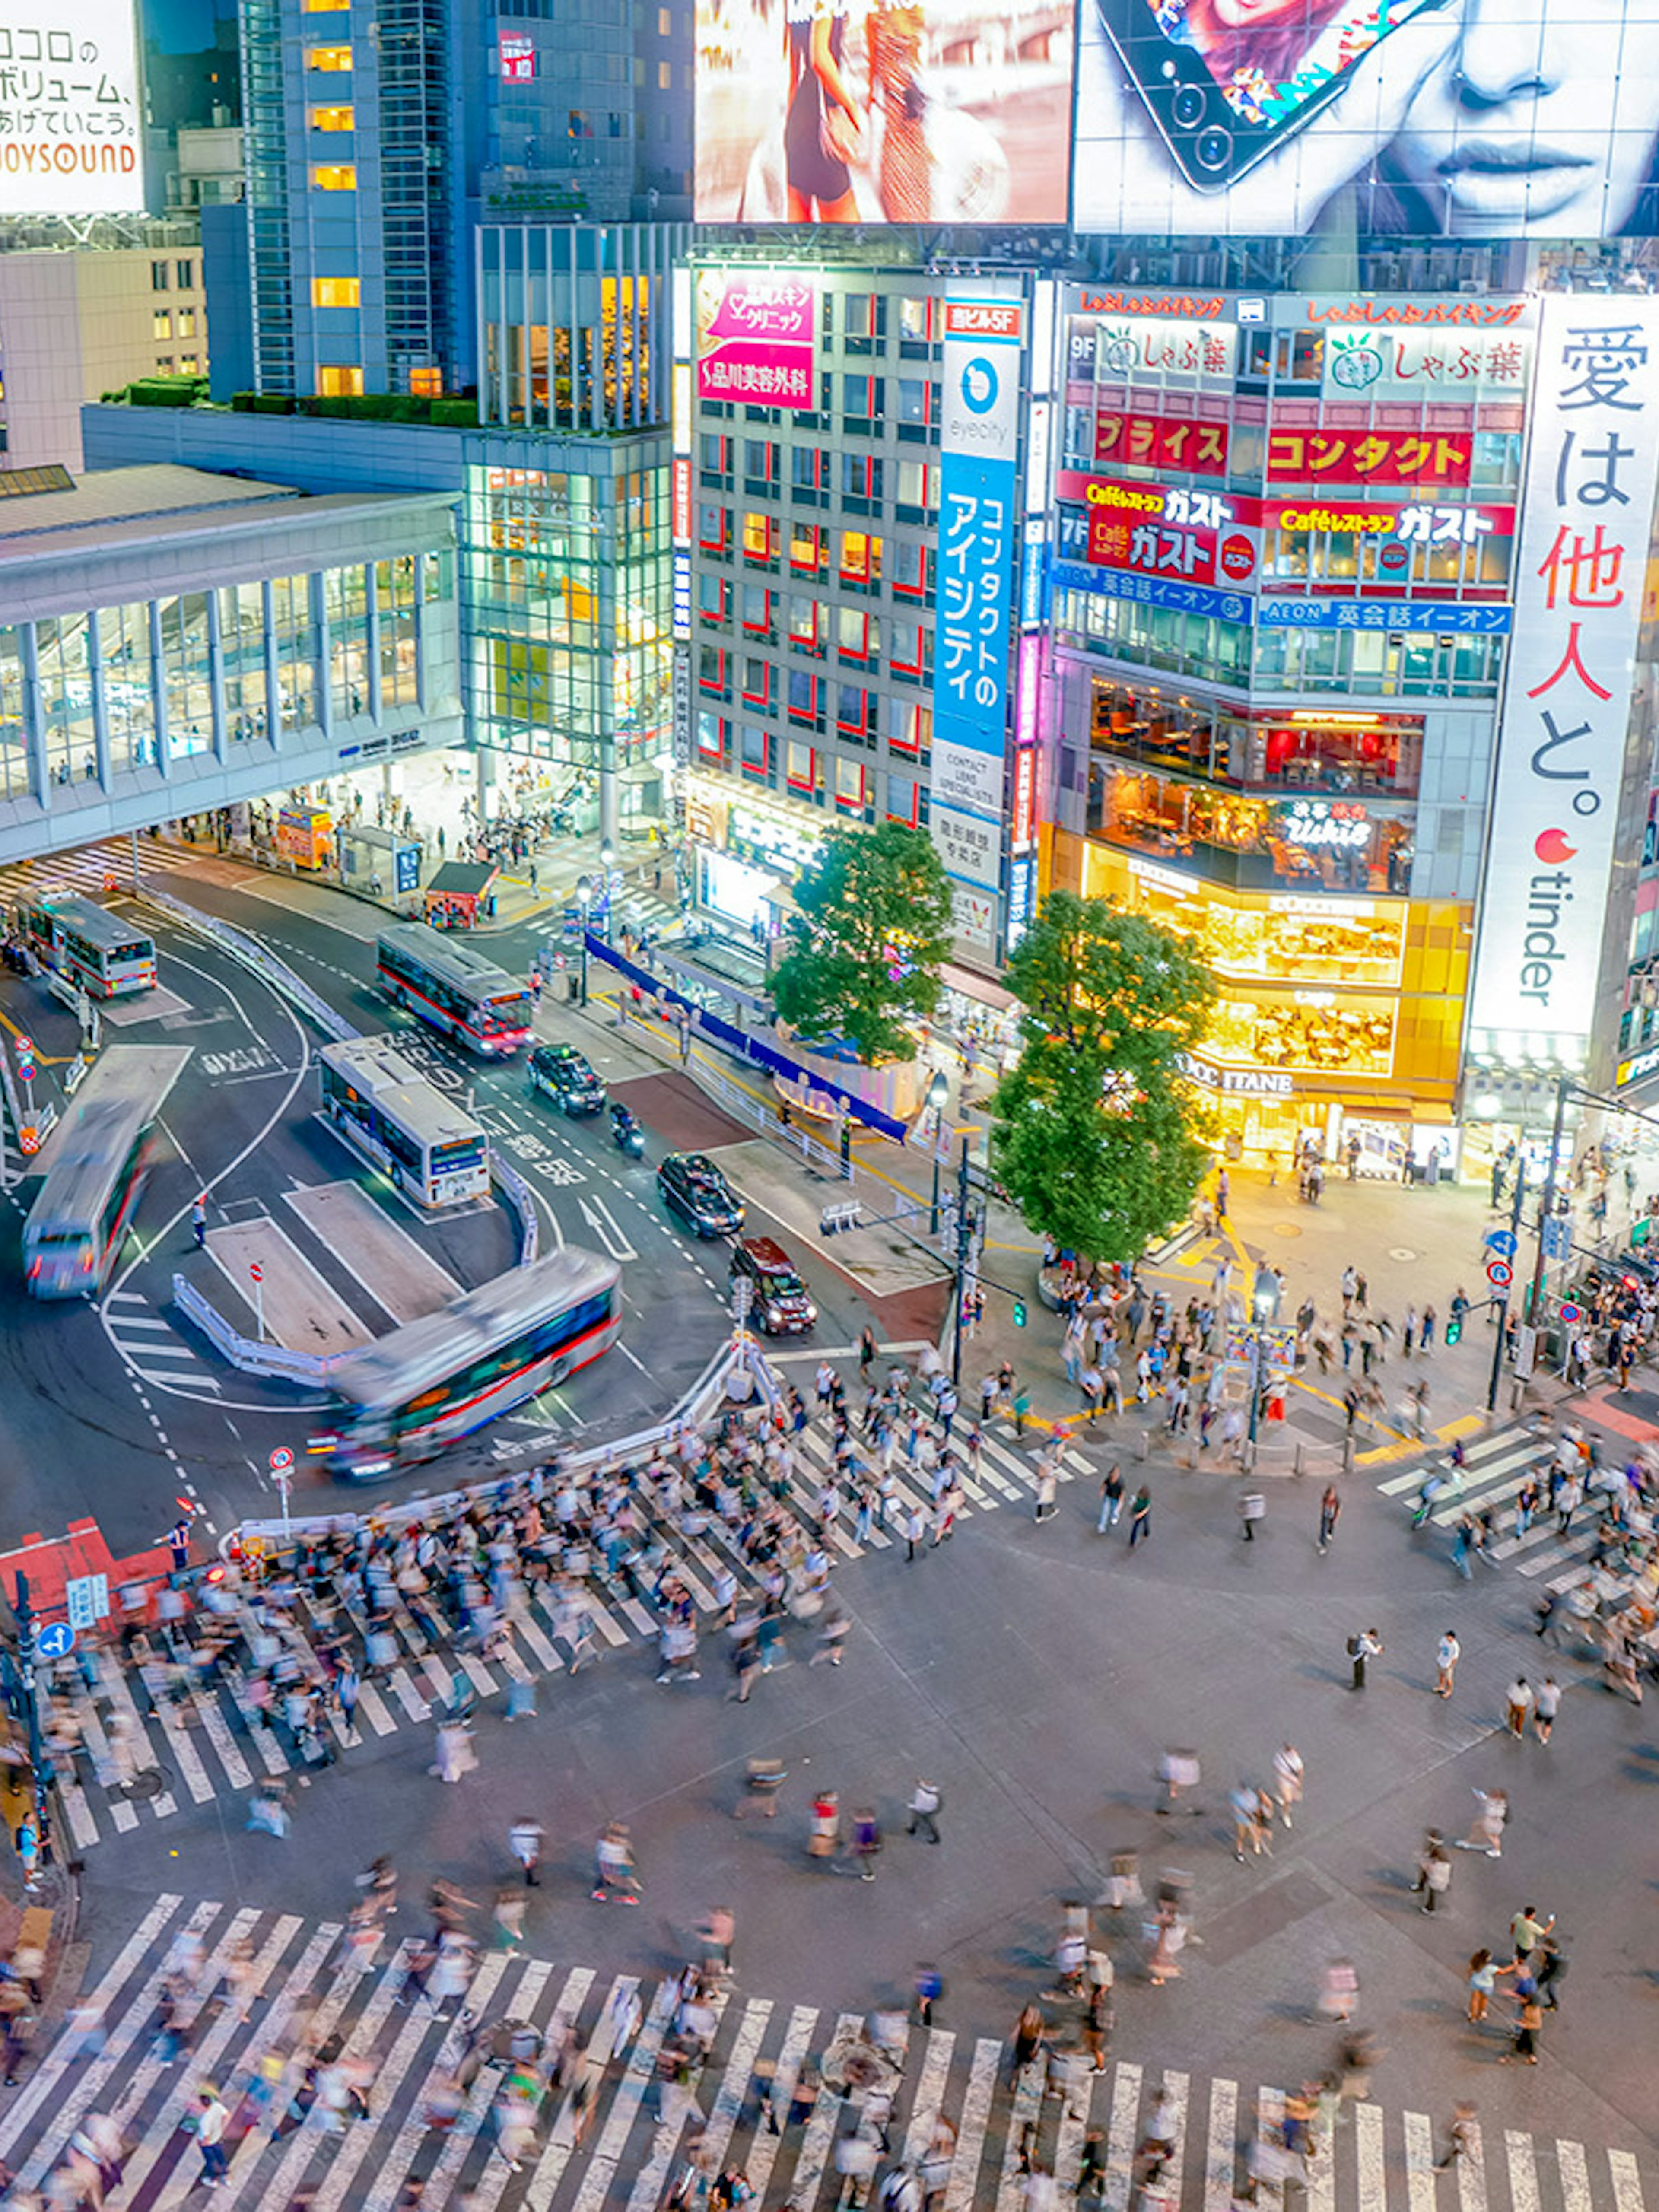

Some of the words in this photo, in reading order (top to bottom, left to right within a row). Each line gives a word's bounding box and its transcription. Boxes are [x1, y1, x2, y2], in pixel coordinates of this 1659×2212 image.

[0, 143, 135, 174] OYSOUND
[747, 308, 802, 331] クリニック
[1080, 291, 1226, 319] しゃぶしゃぶバイキング
[1308, 301, 1526, 325] しゃぶしゃぶバイキング
[1071, 336, 1096, 360] 9F
[1144, 334, 1226, 373] しゃぶ葉
[1395, 341, 1523, 380] しゃぶ葉
[712, 361, 808, 397] 品川美容外科
[1097, 416, 1224, 463] プライス
[1269, 436, 1466, 475] コンタクト
[1165, 489, 1233, 529] ガスト
[1397, 506, 1494, 543] ガスト
[1061, 517, 1089, 546] 7F
[1129, 524, 1210, 575] ガスト
[1527, 324, 1648, 816] 愛は他人と。
[944, 492, 977, 700] アイシティ
[974, 498, 1003, 707] コンタクトの
[1103, 573, 1215, 612] 英会話イーオン
[1268, 604, 1320, 620] AEON
[1337, 603, 1506, 629] 英会話イーオン
[947, 754, 987, 773] CONTACT
[1519, 871, 1573, 1007] tinder
